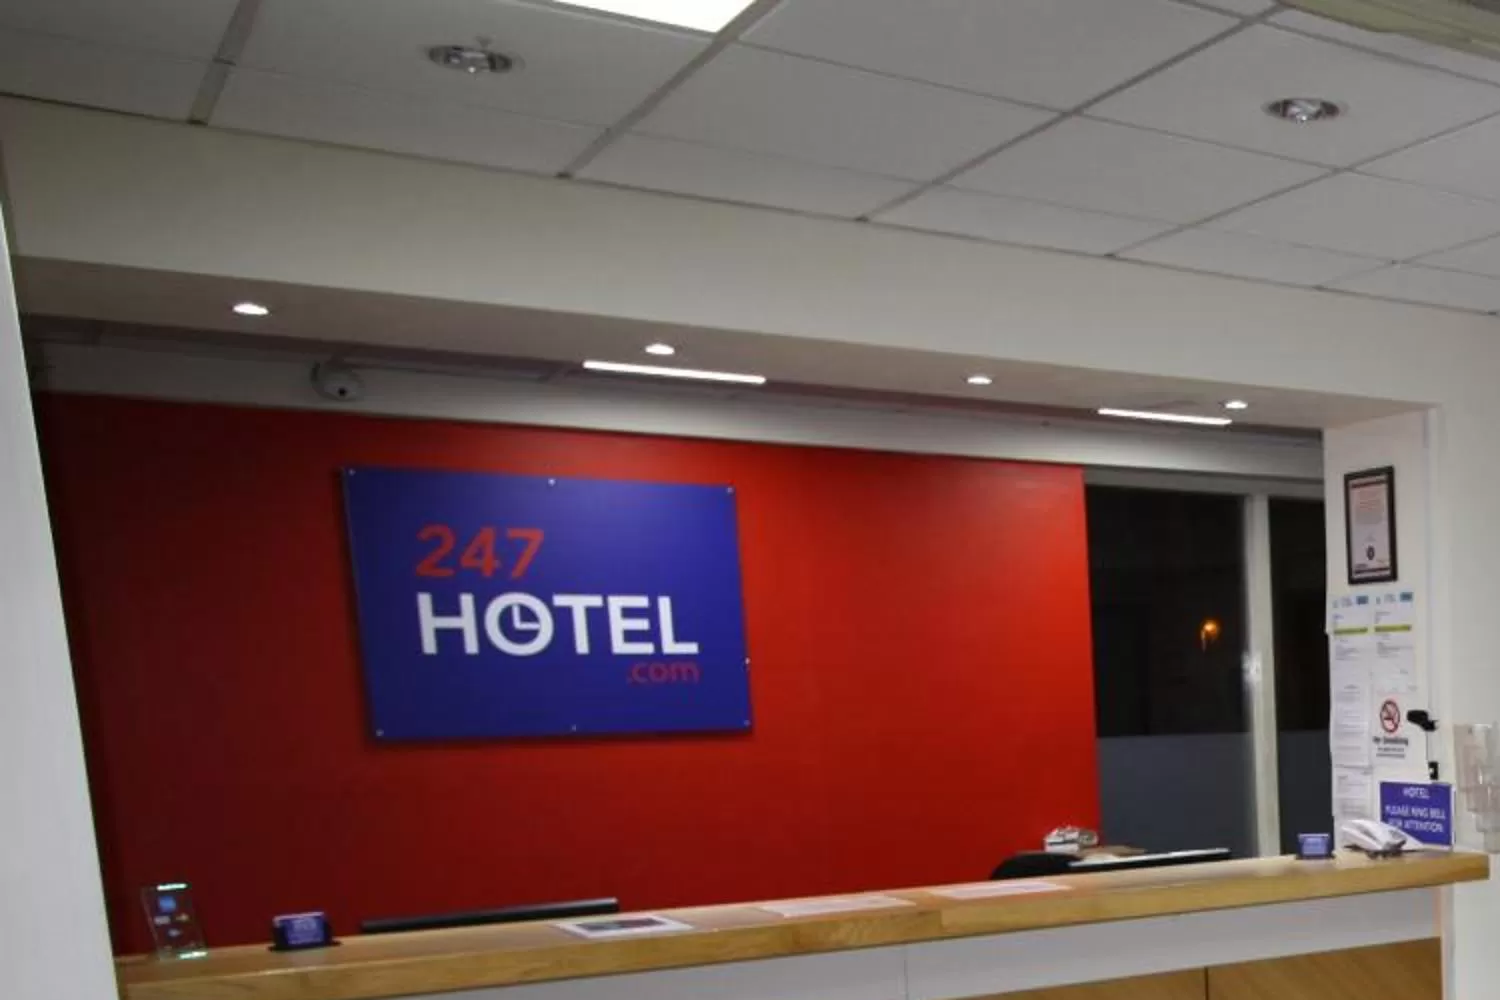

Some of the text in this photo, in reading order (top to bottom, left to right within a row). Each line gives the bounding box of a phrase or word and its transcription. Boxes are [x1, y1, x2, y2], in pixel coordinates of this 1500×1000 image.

[415, 523, 545, 580] 247
[416, 591, 700, 656] HOTEL
[627, 660, 700, 684] .com
